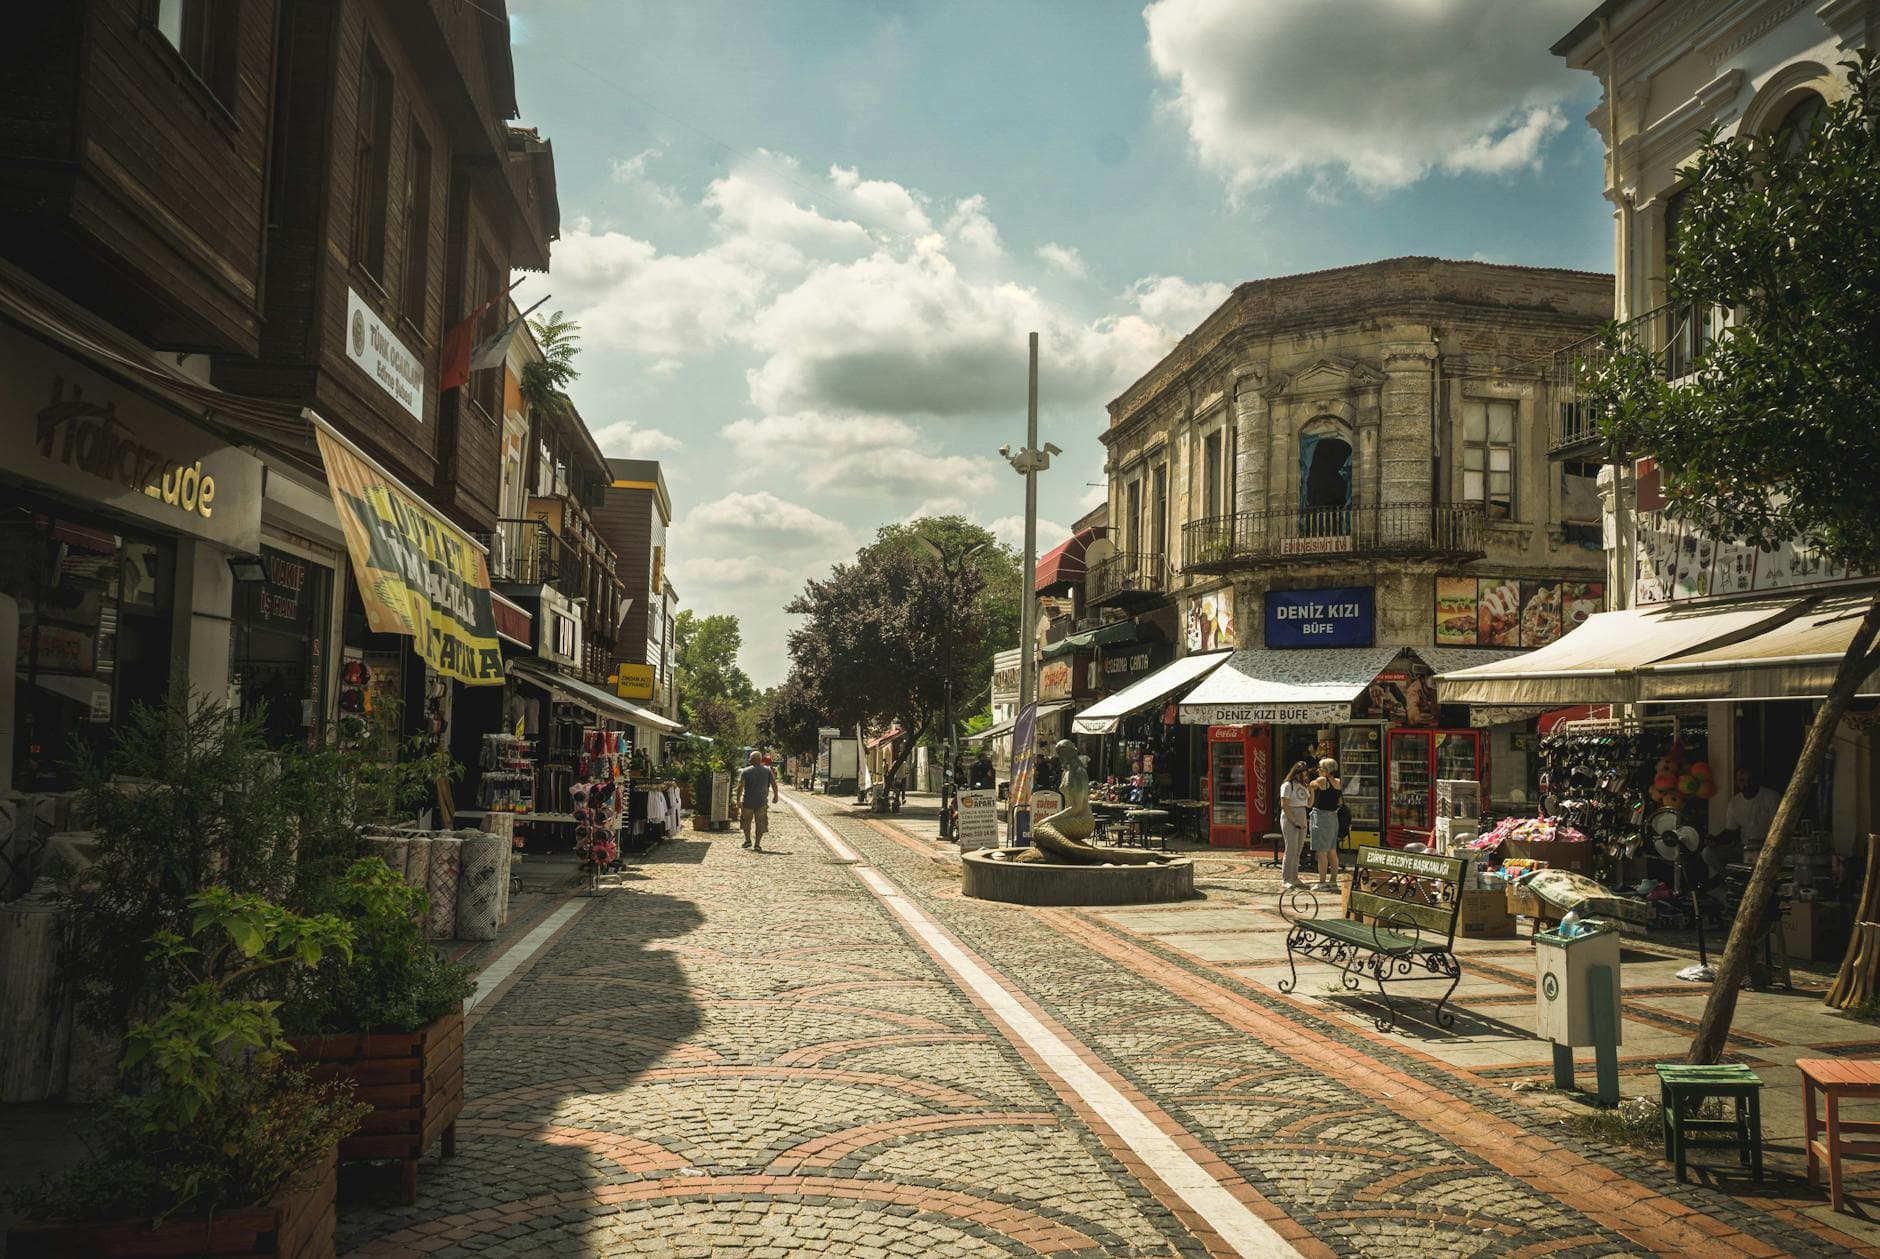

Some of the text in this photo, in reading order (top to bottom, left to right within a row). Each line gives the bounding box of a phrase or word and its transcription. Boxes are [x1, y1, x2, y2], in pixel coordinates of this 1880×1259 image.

[370, 324, 390, 361] TÜRK
[1277, 602, 1359, 620] DENİZ KIZI
[1303, 621, 1334, 634] BÜFE
[1216, 709, 1250, 720] DENİZ
[1253, 710, 1276, 720] KIZI
[1279, 707, 1308, 720] BÜFE
[1366, 850, 1450, 876] EDİRNE BELEDİYE BAŞKANLIĞI
